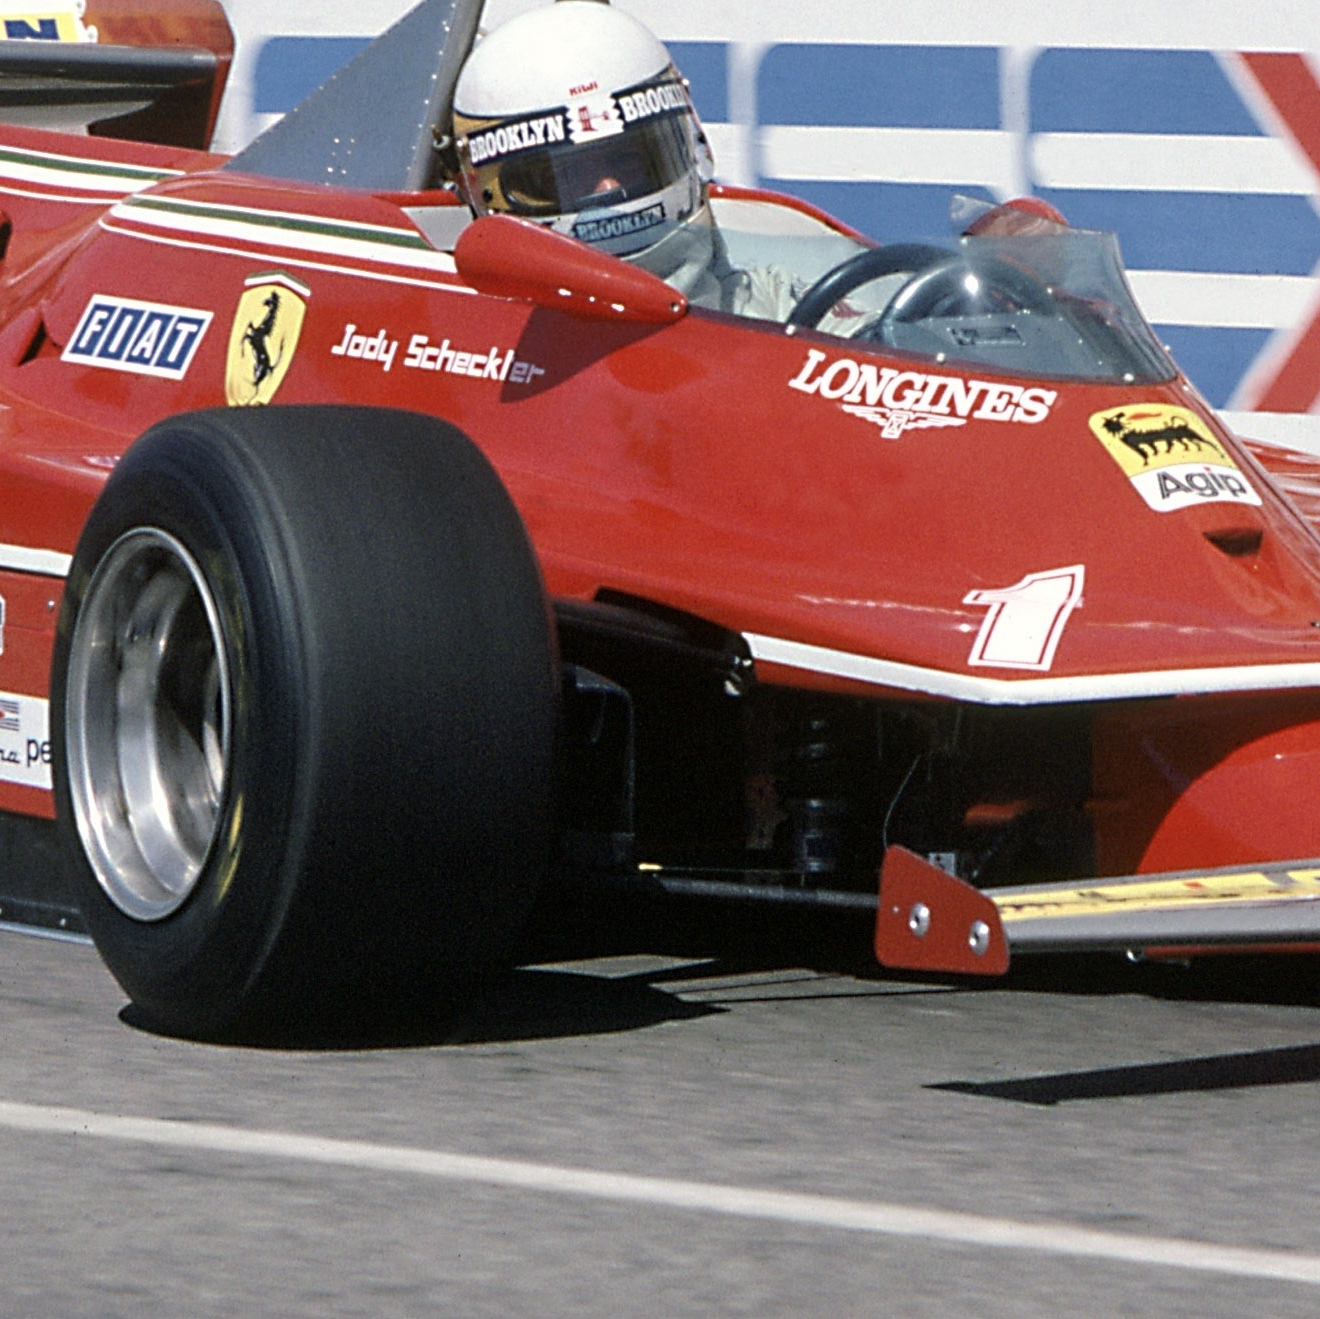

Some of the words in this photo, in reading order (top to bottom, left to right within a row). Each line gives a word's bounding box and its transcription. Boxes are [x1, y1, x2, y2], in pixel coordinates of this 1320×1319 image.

[469, 113, 566, 165] BROOKLYN
[76, 303, 201, 370] FIAT
[330, 322, 398, 372] Jody
[403, 333, 546, 385] Scheckler
[788, 349, 1058, 425] LONGINES
[1157, 465, 1247, 500] Agip
[962, 564, 1085, 671] 1
